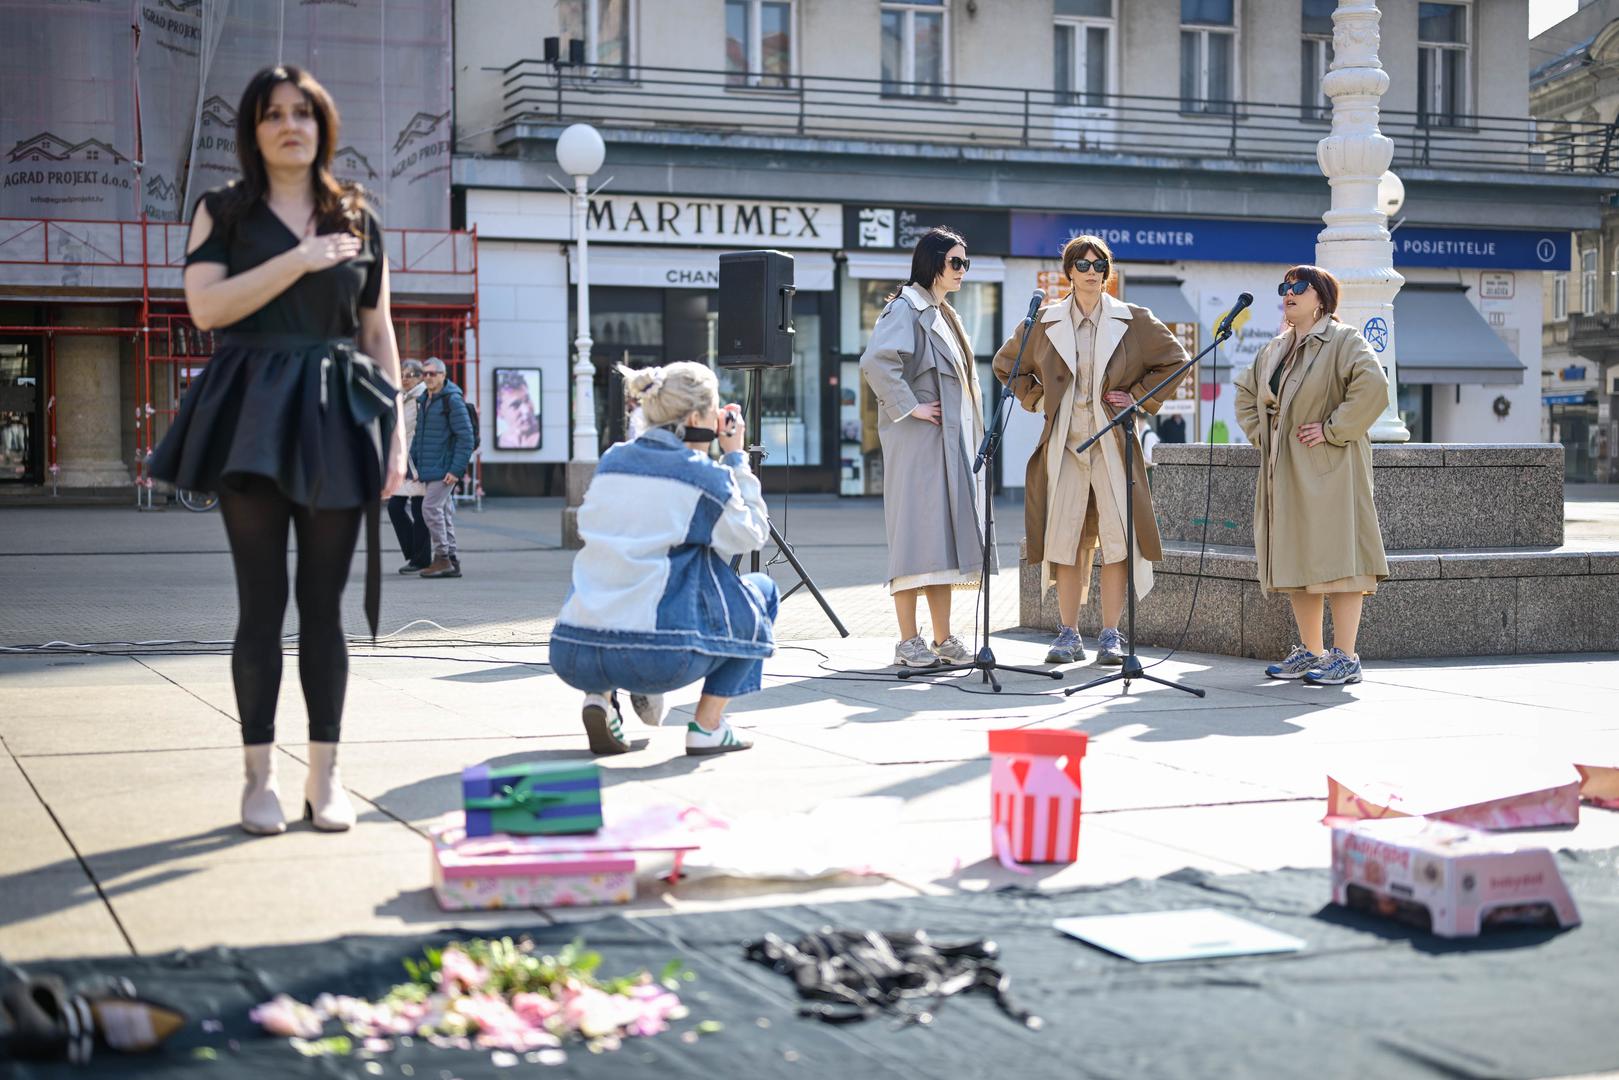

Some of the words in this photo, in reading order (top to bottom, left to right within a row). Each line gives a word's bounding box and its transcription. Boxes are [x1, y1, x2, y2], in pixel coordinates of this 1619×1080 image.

[4, 171, 44, 188] AGRAD
[48, 171, 98, 186] PROJEKT
[102, 173, 132, 190] d.o.o.
[586, 200, 820, 238] MARTIMEX
[1136, 231, 1194, 246] CENTER
[1403, 240, 1496, 256] POSJETITELJE
[666, 270, 719, 283] CHAN
